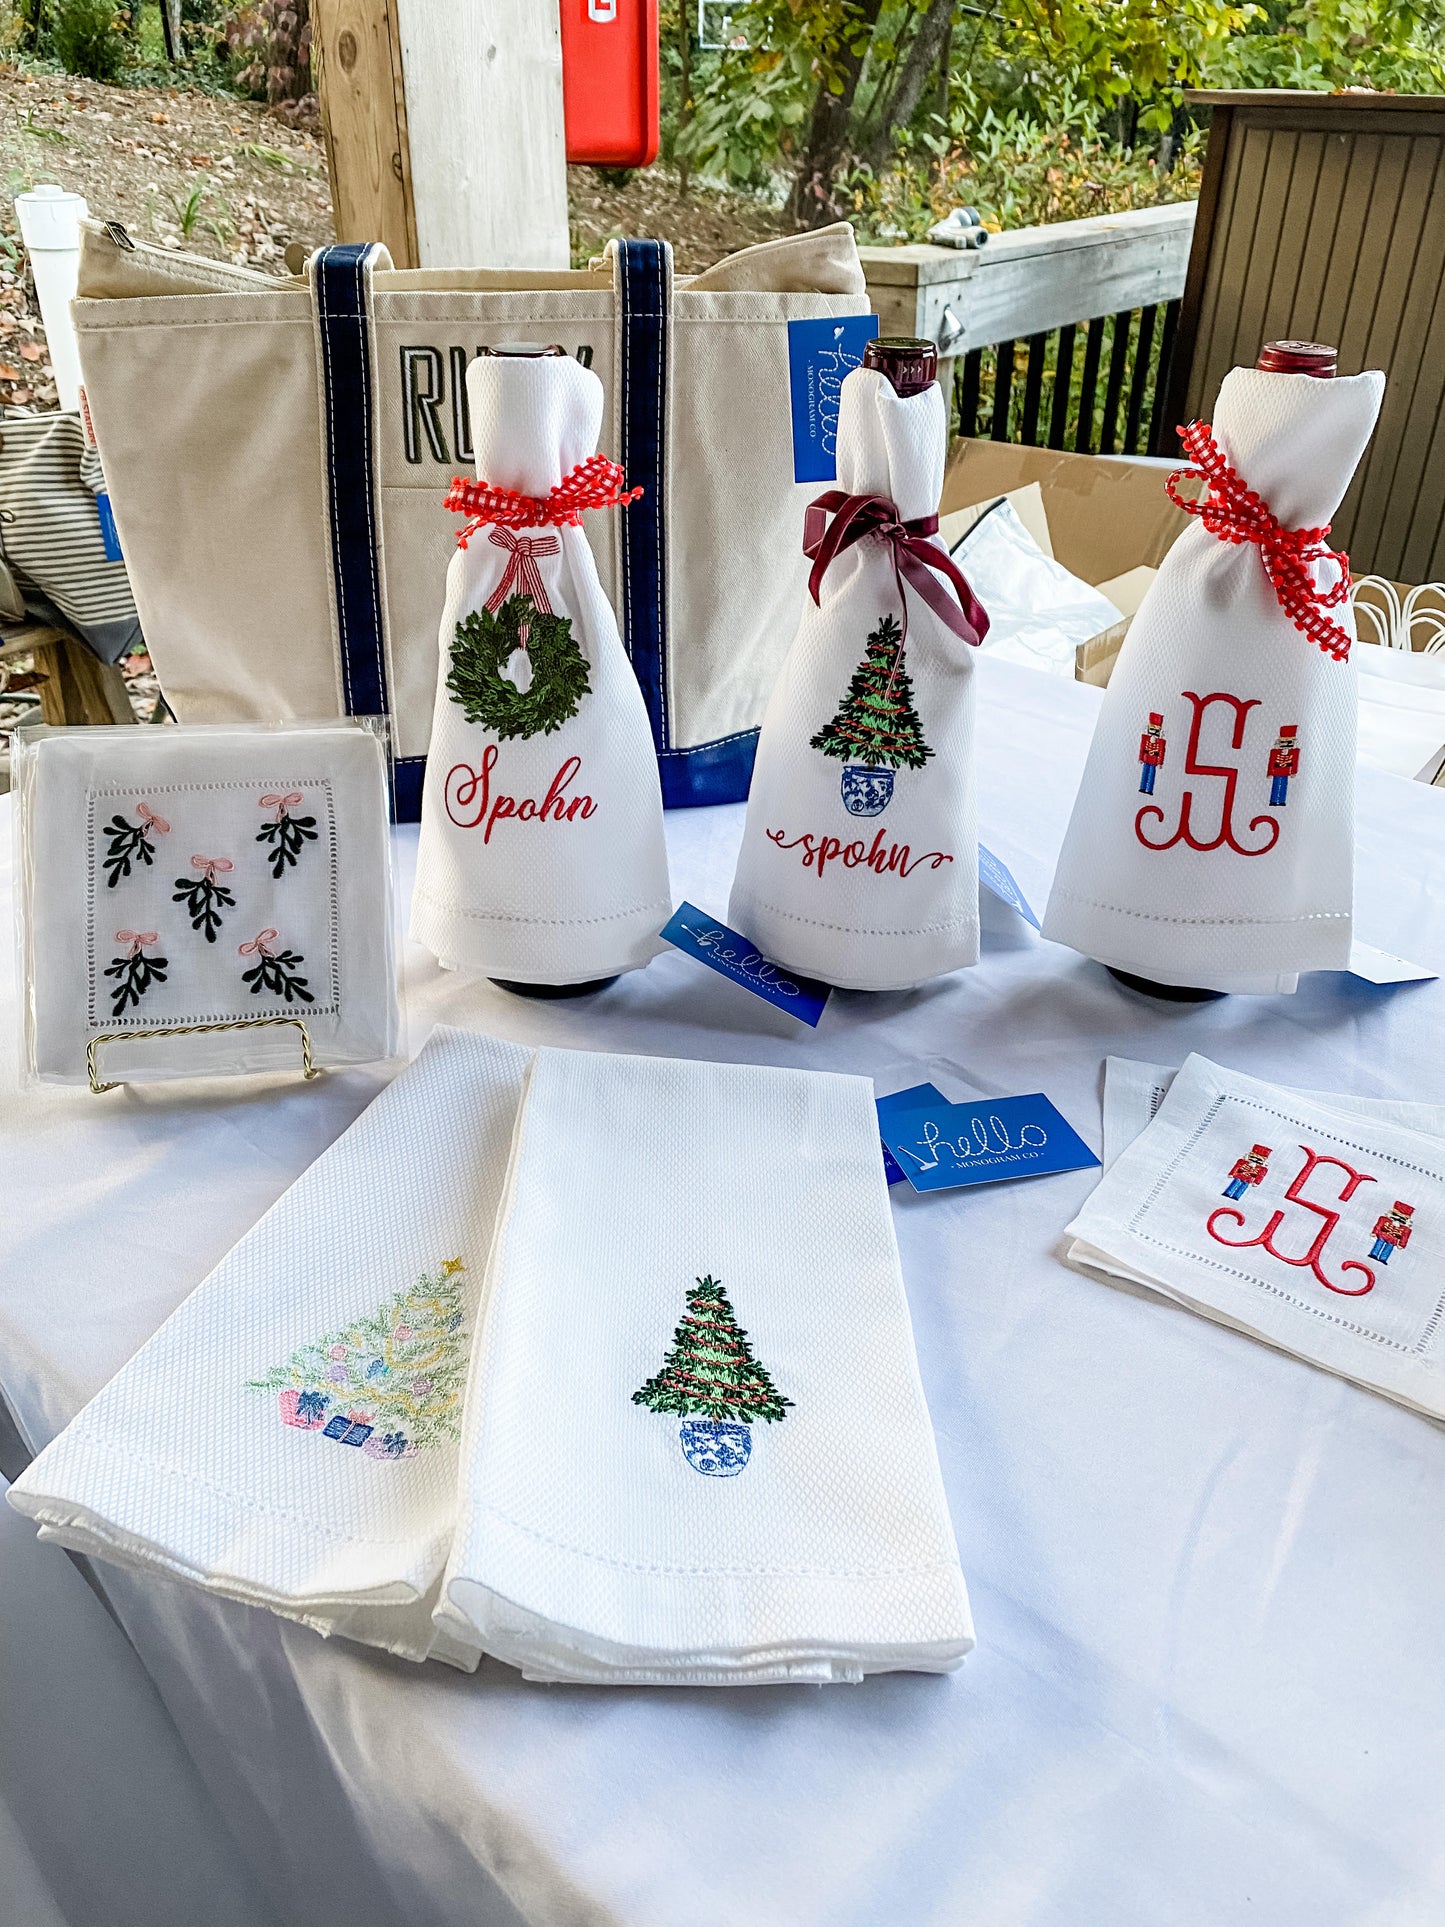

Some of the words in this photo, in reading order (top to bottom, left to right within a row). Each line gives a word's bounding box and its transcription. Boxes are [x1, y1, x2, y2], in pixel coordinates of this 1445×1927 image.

[806, 365, 816, 421] MONOGRAM
[809, 423, 817, 438] CO
[444, 744, 598, 845] Spohn
[766, 827, 954, 878] spohn
[696, 930, 800, 996] hello
[706, 951, 760, 986] MONOGRAM
[916, 1115, 1048, 1161] hello
[956, 1154, 1021, 1169] MONOGRAM
[1022, 1151, 1039, 1159] CO
